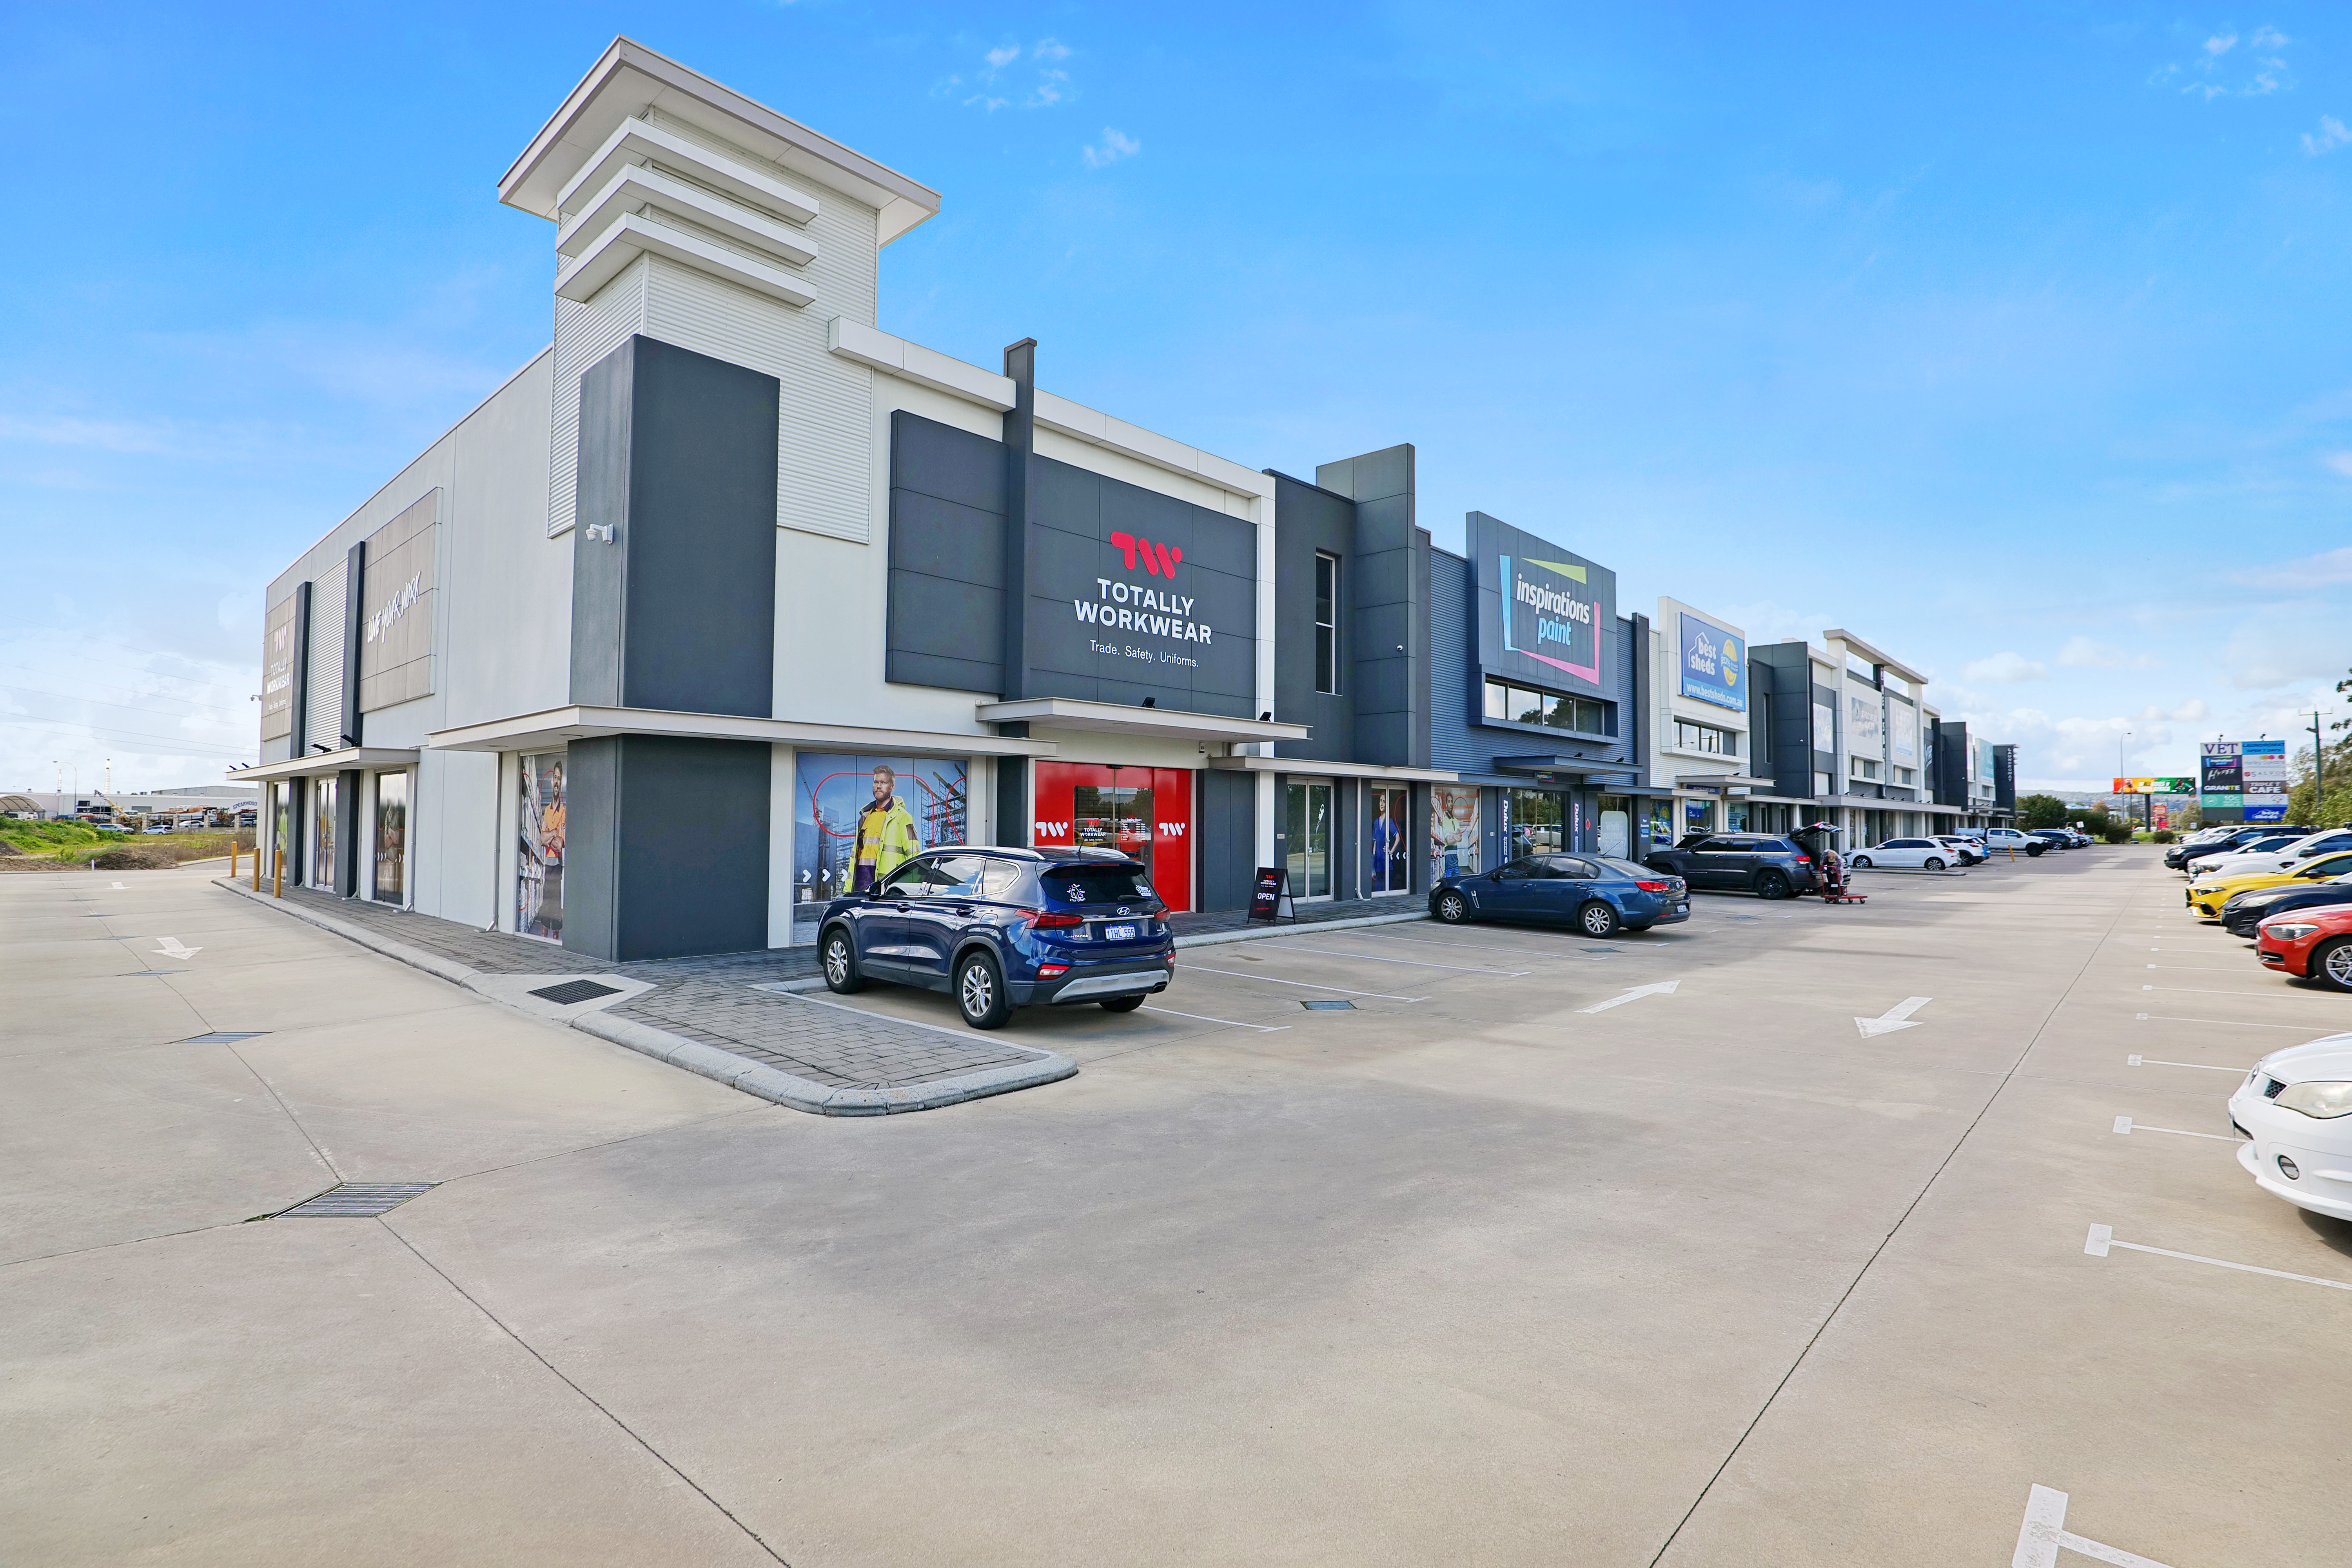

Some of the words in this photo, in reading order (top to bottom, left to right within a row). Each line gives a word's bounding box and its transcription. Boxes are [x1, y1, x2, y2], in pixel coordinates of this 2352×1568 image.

[1097, 577, 1194, 617] TOTALLY
[1517, 573, 1590, 624] inspirations
[381, 590, 402, 643] YOUR
[1074, 599, 1212, 645] WORKWEAR
[1537, 615, 1572, 646] paint
[1090, 639, 1120, 655] Trade.
[1125, 645, 1156, 664] Safety.
[1160, 651, 1199, 668] Uniforms.
[1698, 637, 1717, 660] best
[270, 657, 287, 677] TOTALLY
[1691, 653, 1715, 676] sheds
[267, 672, 290, 695] WORKWEAR
[1687, 683, 1743, 707] www.bestsheds.com.au
[2204, 743, 2238, 754] VET
[232, 801, 258, 809] SPEARWOOD
[1257, 892, 1275, 900] OPEN
